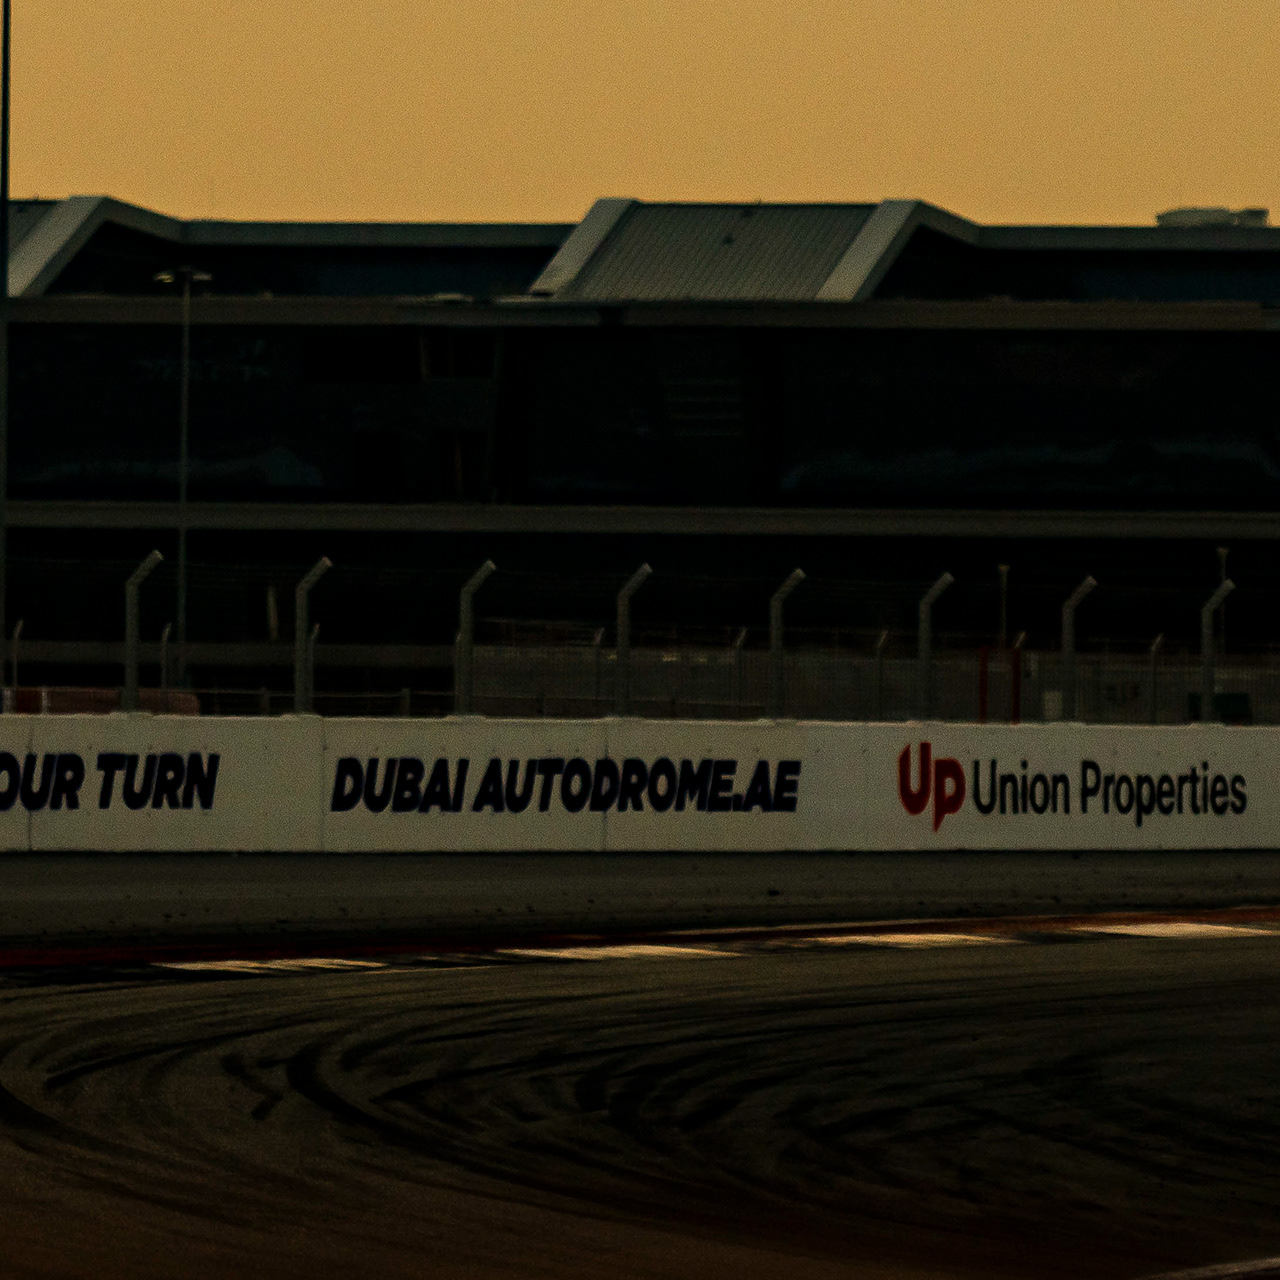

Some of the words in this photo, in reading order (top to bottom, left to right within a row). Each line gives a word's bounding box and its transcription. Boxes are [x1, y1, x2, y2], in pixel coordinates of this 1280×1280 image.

[97, 752, 221, 811] TURN
[331, 757, 469, 814] DUBAI
[472, 757, 801, 814] AUTODROME.AE
[972, 759, 1070, 815] Union
[1081, 759, 1247, 827] Properties
